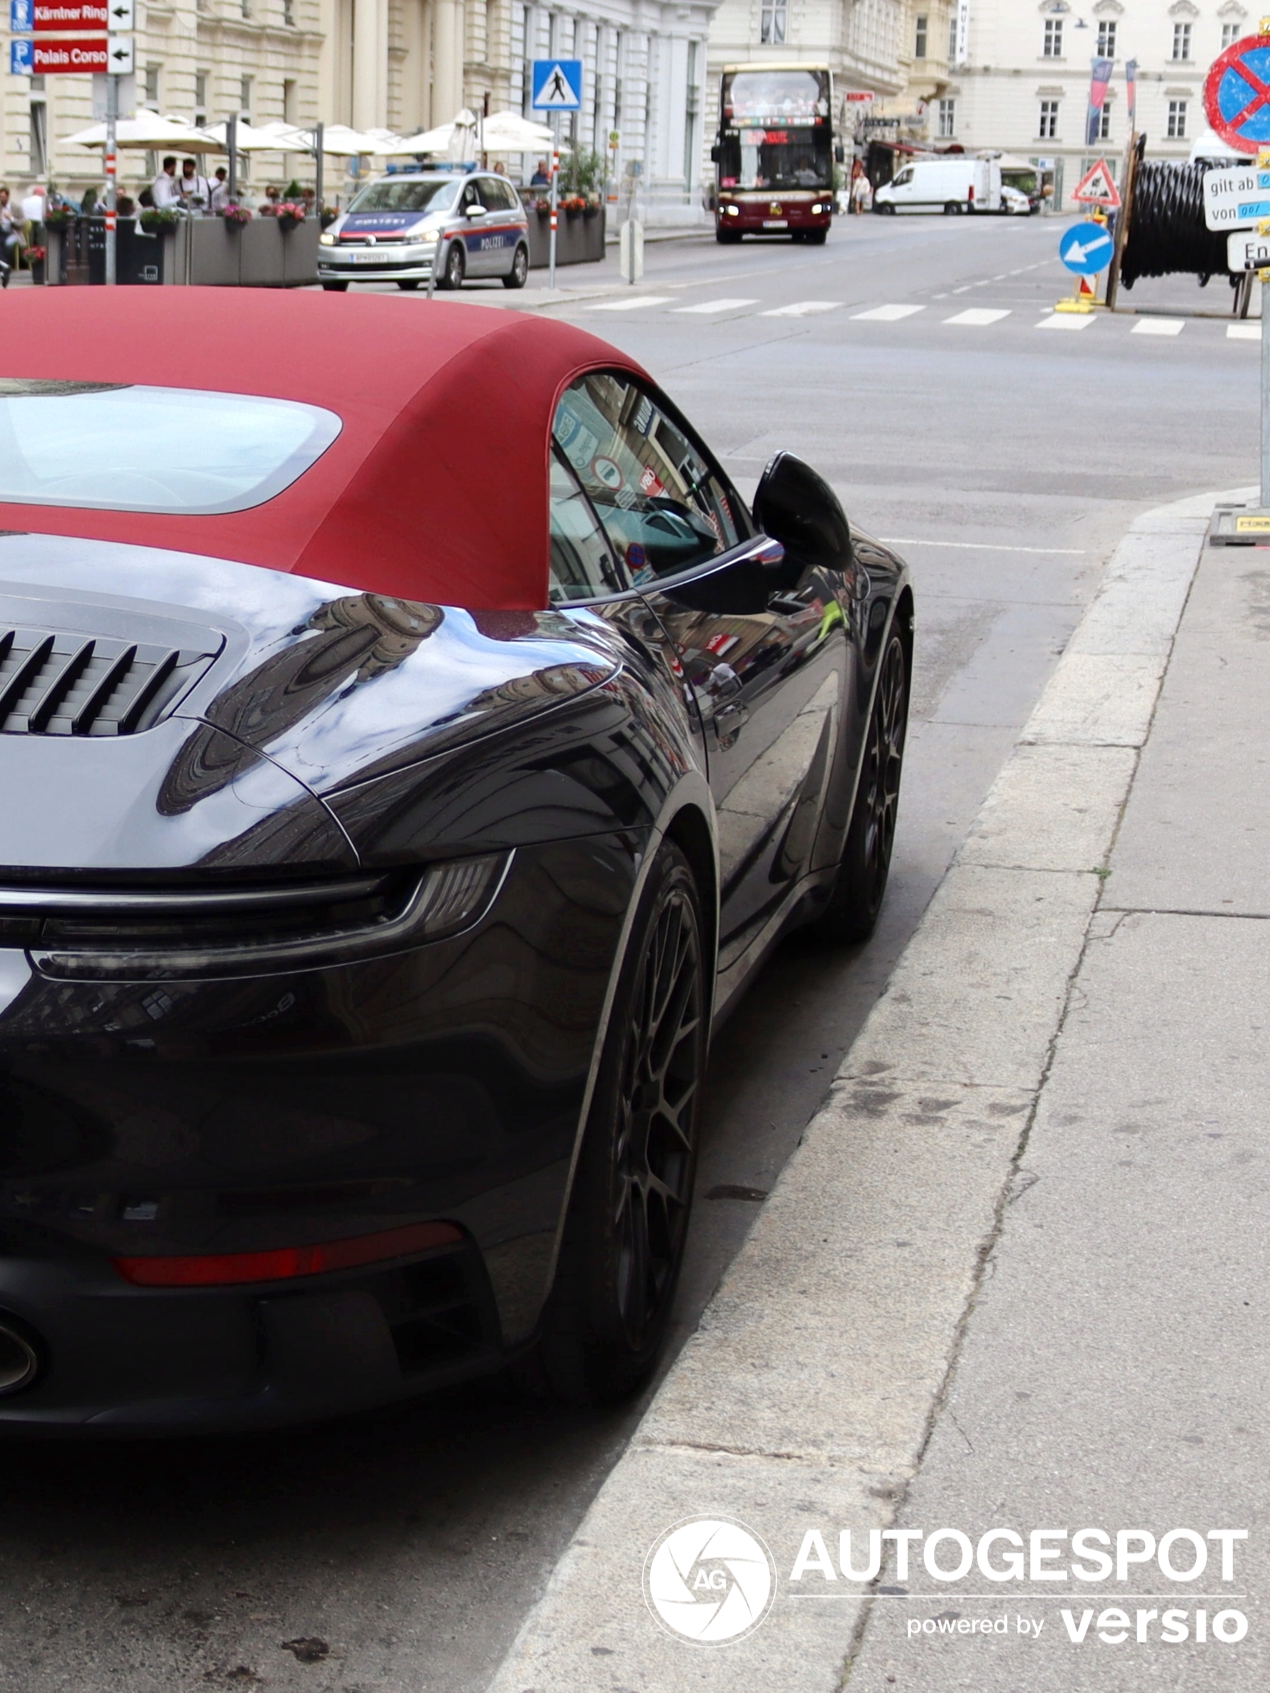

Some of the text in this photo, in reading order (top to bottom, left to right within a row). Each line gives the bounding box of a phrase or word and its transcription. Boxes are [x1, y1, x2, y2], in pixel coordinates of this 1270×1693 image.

[34, 5, 108, 22] Kärntner Ring
[34, 47, 108, 64] Palais Corso
[1210, 178, 1234, 198] gilt
[1238, 177, 1254, 191] ab
[1211, 207, 1237, 220] von
[354, 217, 407, 226] POLIZEI
[481, 236, 505, 250] POLIZEI
